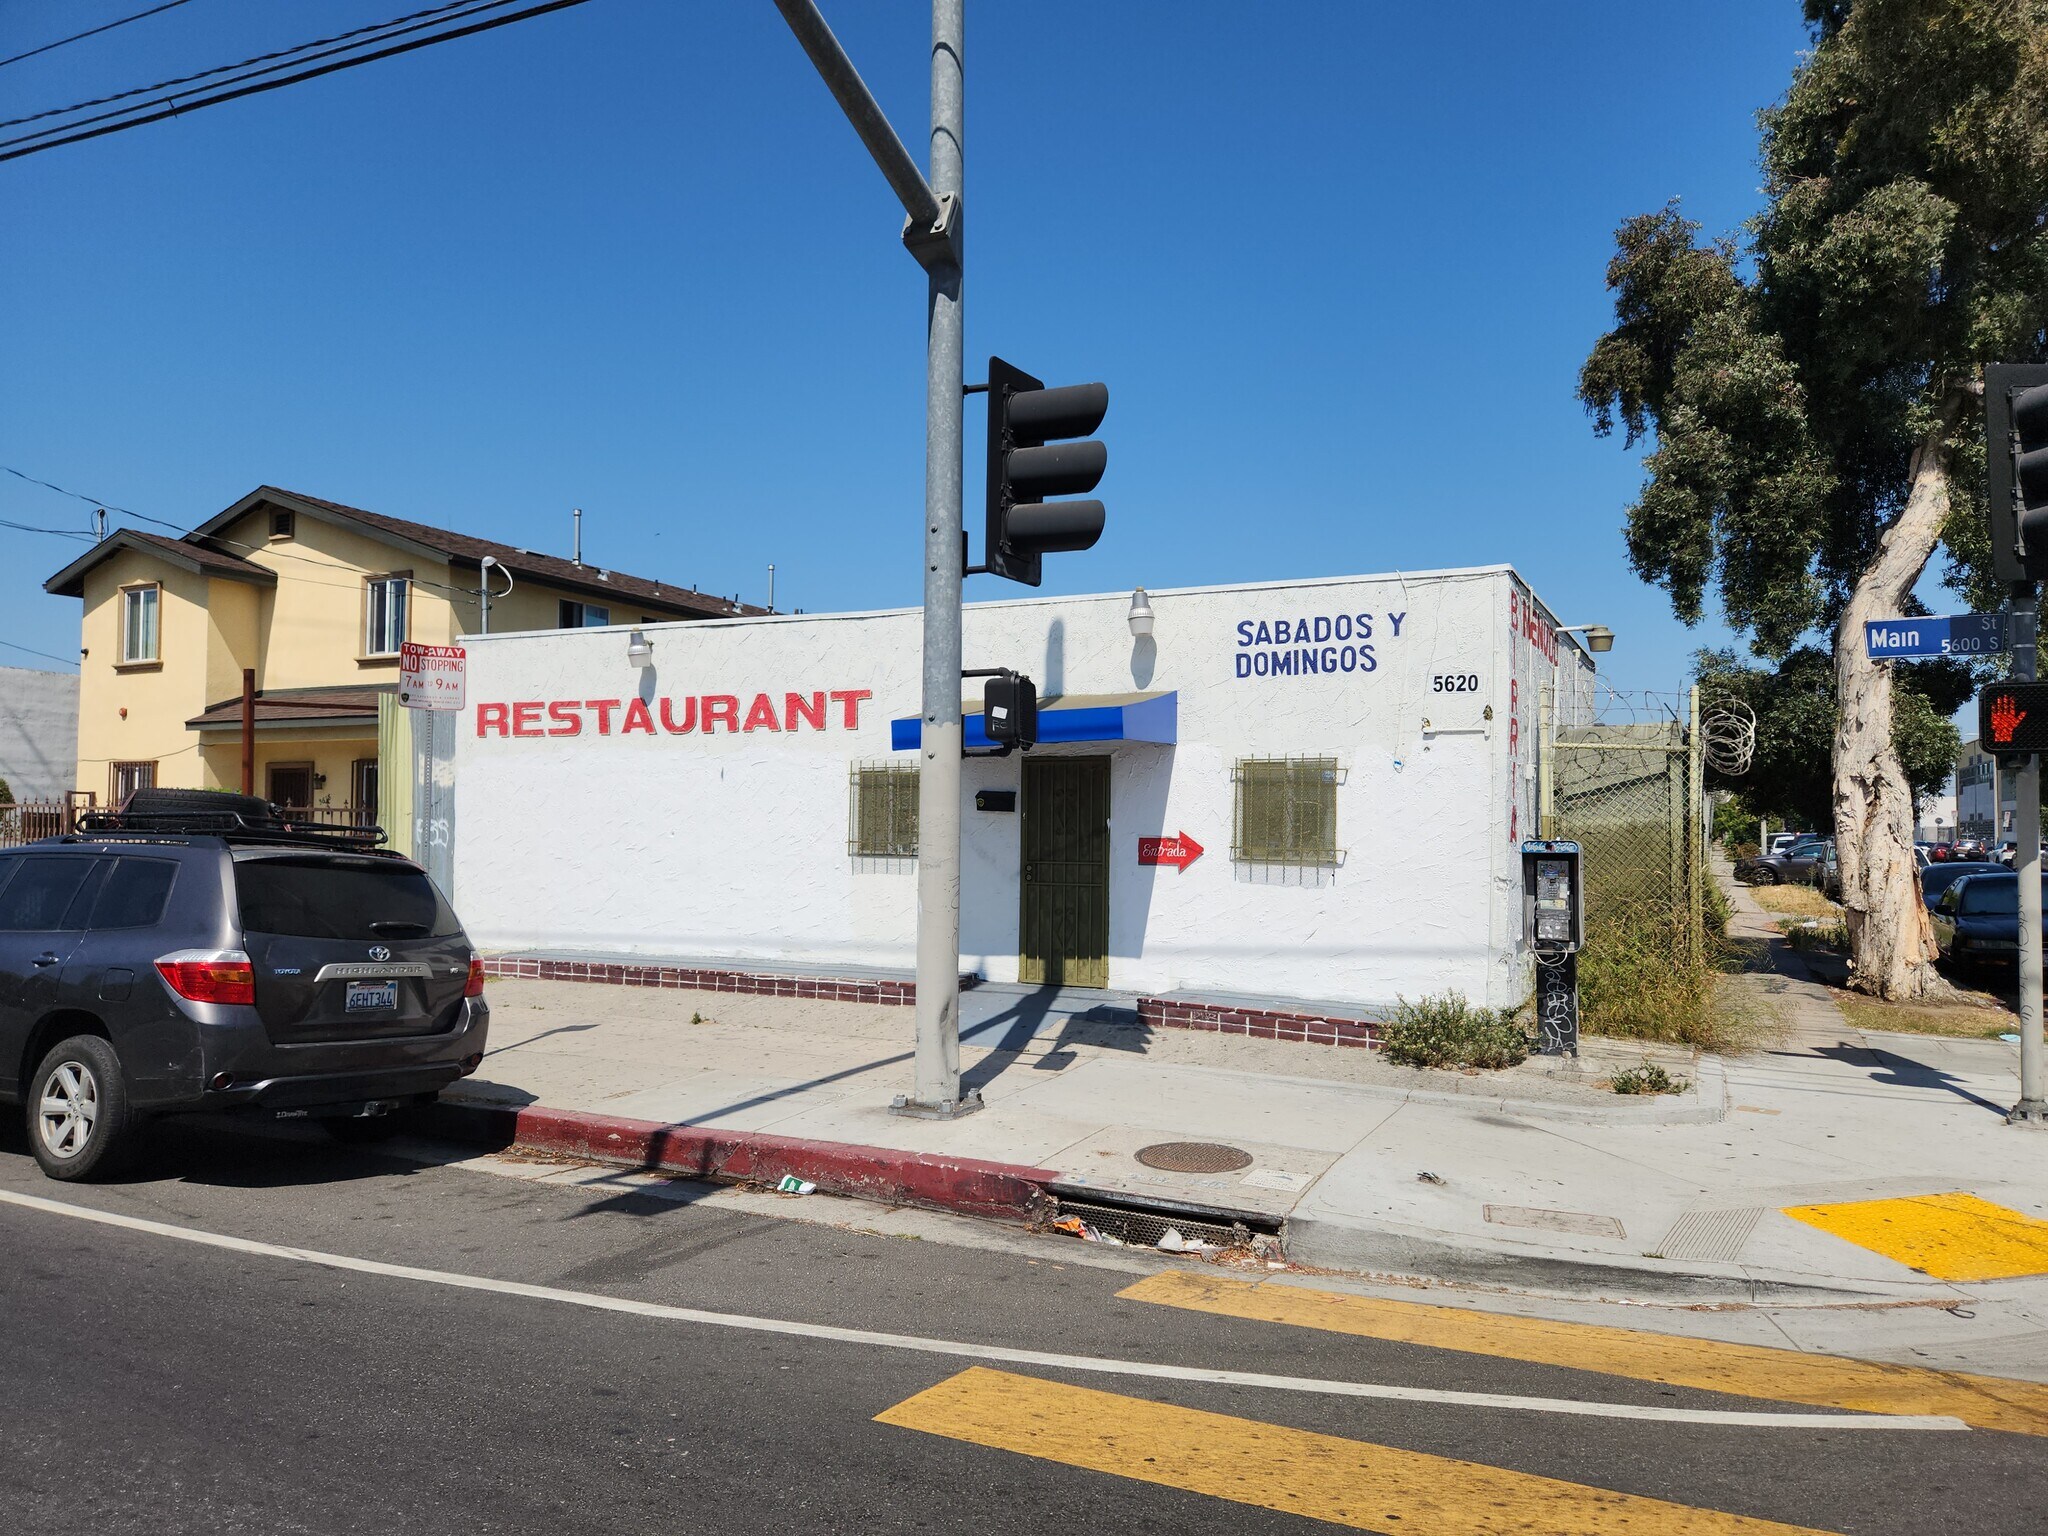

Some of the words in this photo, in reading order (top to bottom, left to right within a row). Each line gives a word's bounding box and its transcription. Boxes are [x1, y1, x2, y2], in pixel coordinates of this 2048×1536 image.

[1237, 613, 1373, 647] SABADOS
[1388, 612, 1407, 637] Y
[1871, 628, 1919, 648] Main
[1981, 616, 1997, 631] St
[404, 644, 462, 657] TOW-AWAY
[1941, 637, 1980, 653] 5600
[1989, 636, 1999, 650] S
[402, 654, 418, 671] NO
[421, 659, 463, 672] STOPPING
[1236, 644, 1378, 678] DOMINGOS
[1432, 674, 1479, 693] 5620
[476, 689, 872, 738] RESTAURANT
[1510, 588, 1518, 843] BIRRIA
[1142, 839, 1187, 857] Entrada
[336, 966, 422, 975] HIGHLANDER
[349, 991, 393, 1007] 6EHT344
